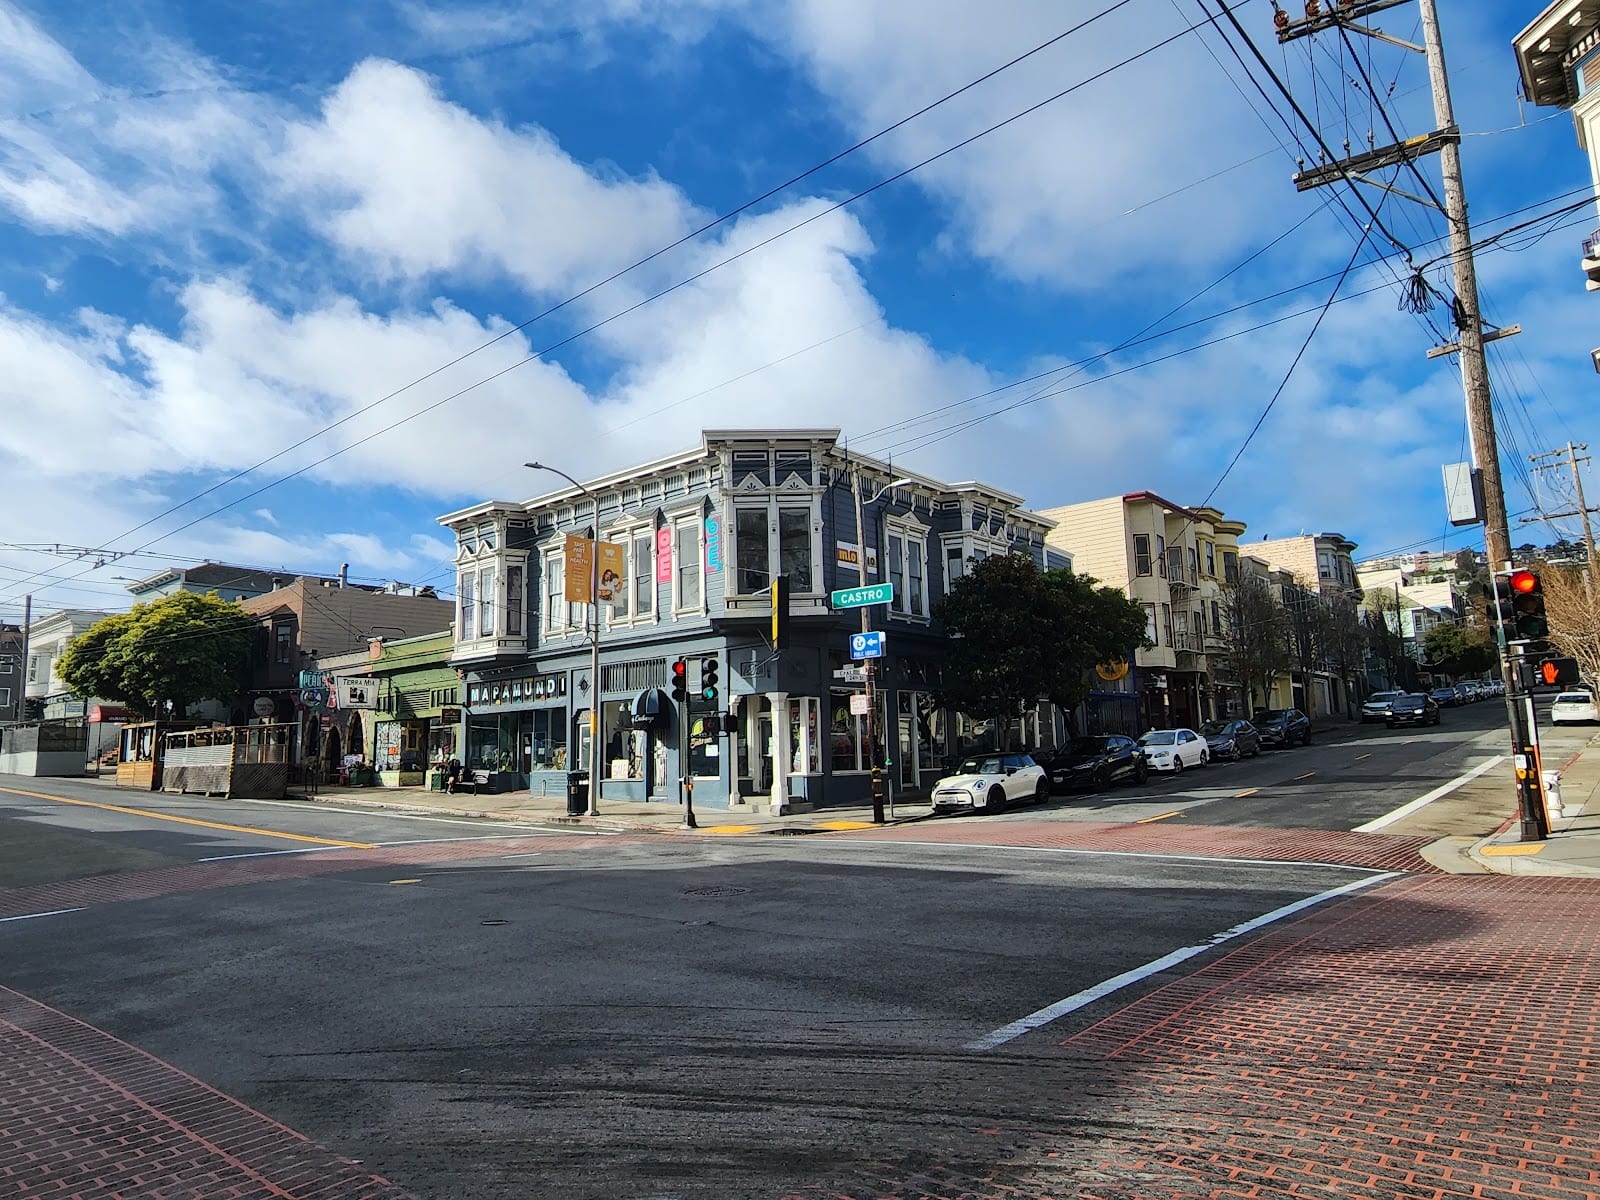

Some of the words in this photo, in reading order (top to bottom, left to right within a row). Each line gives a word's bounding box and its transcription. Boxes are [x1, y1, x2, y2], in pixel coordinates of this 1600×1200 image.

[841, 589, 883, 604] CASTRO
[343, 678, 362, 686] TERRA
[471, 678, 566, 702] MAPAMUNDI
